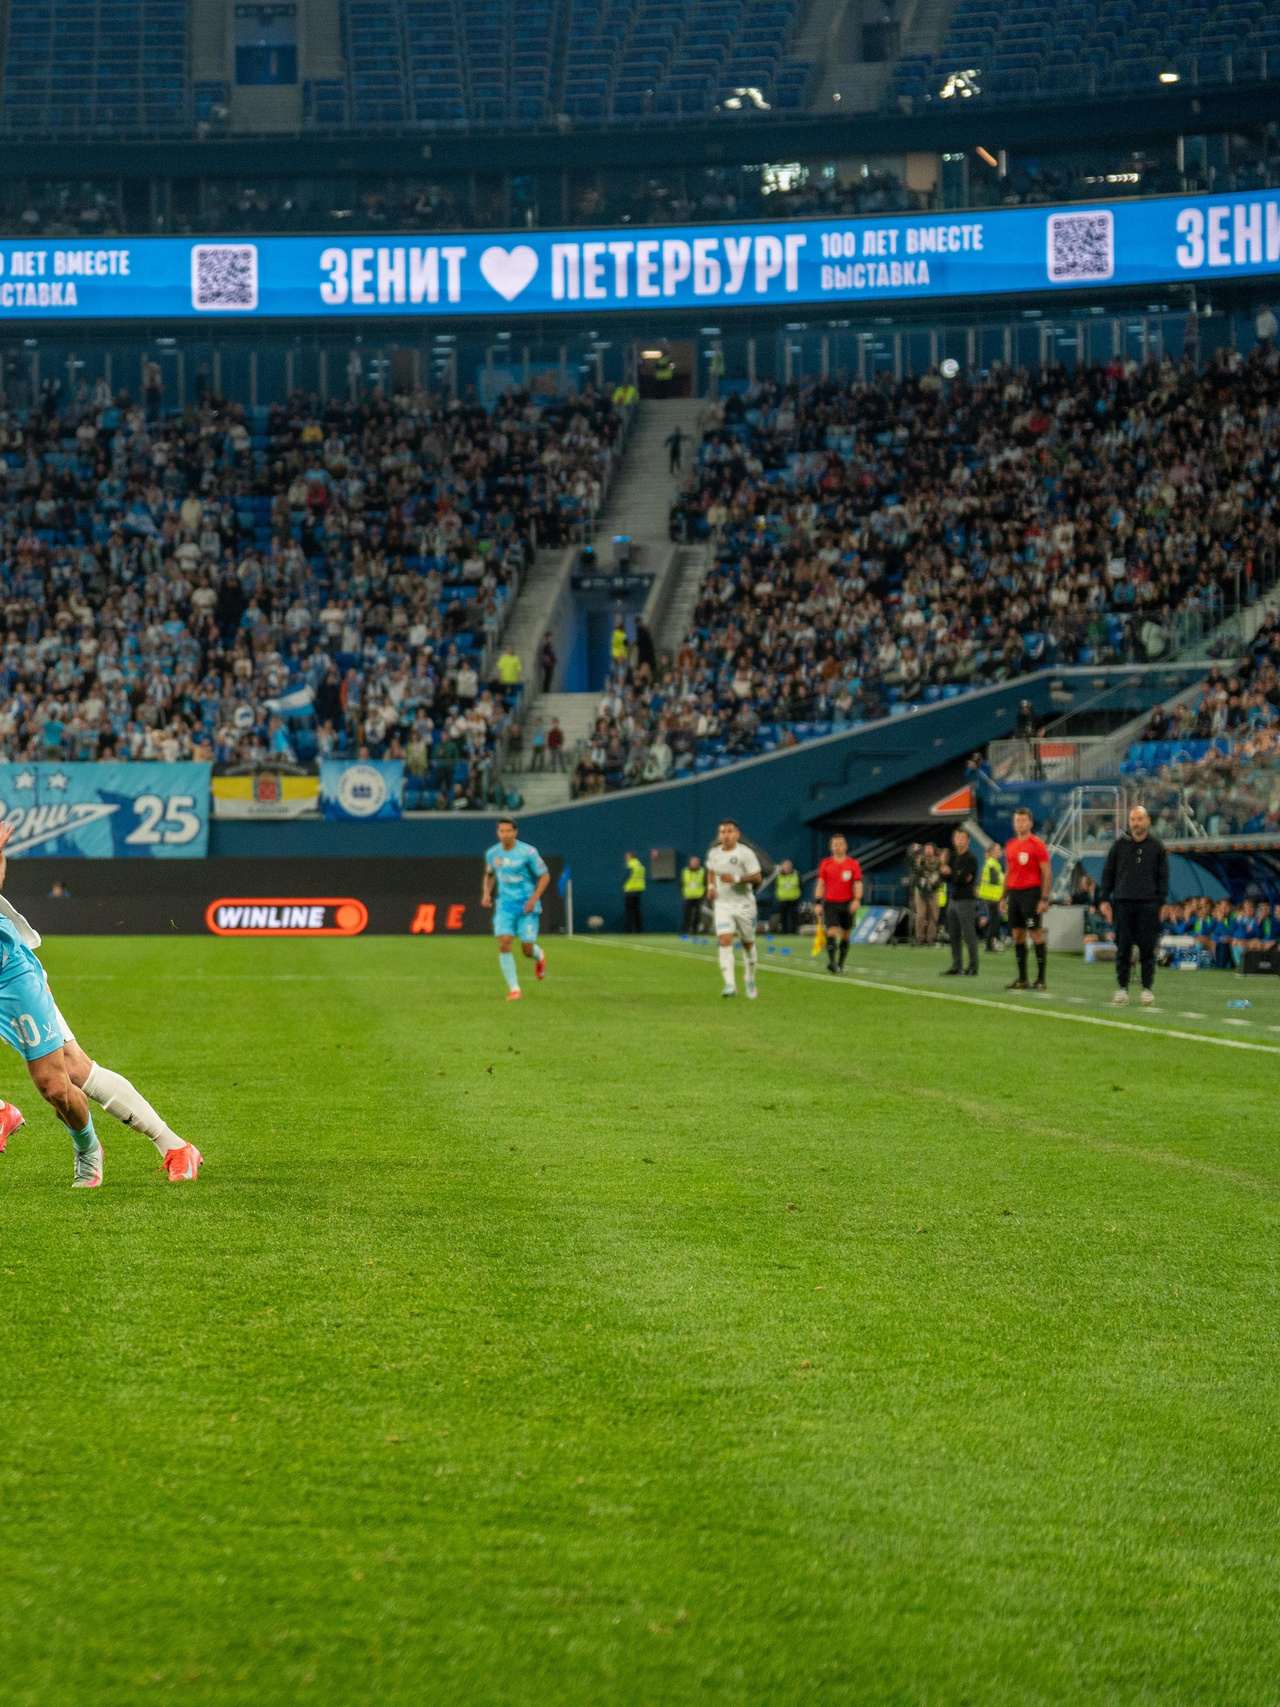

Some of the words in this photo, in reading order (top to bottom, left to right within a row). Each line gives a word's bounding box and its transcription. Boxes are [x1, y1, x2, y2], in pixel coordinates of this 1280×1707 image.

[821, 232, 856, 258] 100
[862, 229, 898, 256] ЛЕТ
[906, 223, 984, 253] ВМЕСТЕ
[10, 251, 47, 276] ЛЕТ
[54, 250, 130, 276] ВМЕСТЕ
[320, 246, 467, 304] ЗЕНИТ
[551, 234, 807, 300] ПЕТЕРБУРГ
[821, 262, 931, 290] ВЫСТАВКА
[125, 794, 201, 844] 25
[218, 906, 326, 929] WINLINE
[9, 1012, 41, 1050] 10
